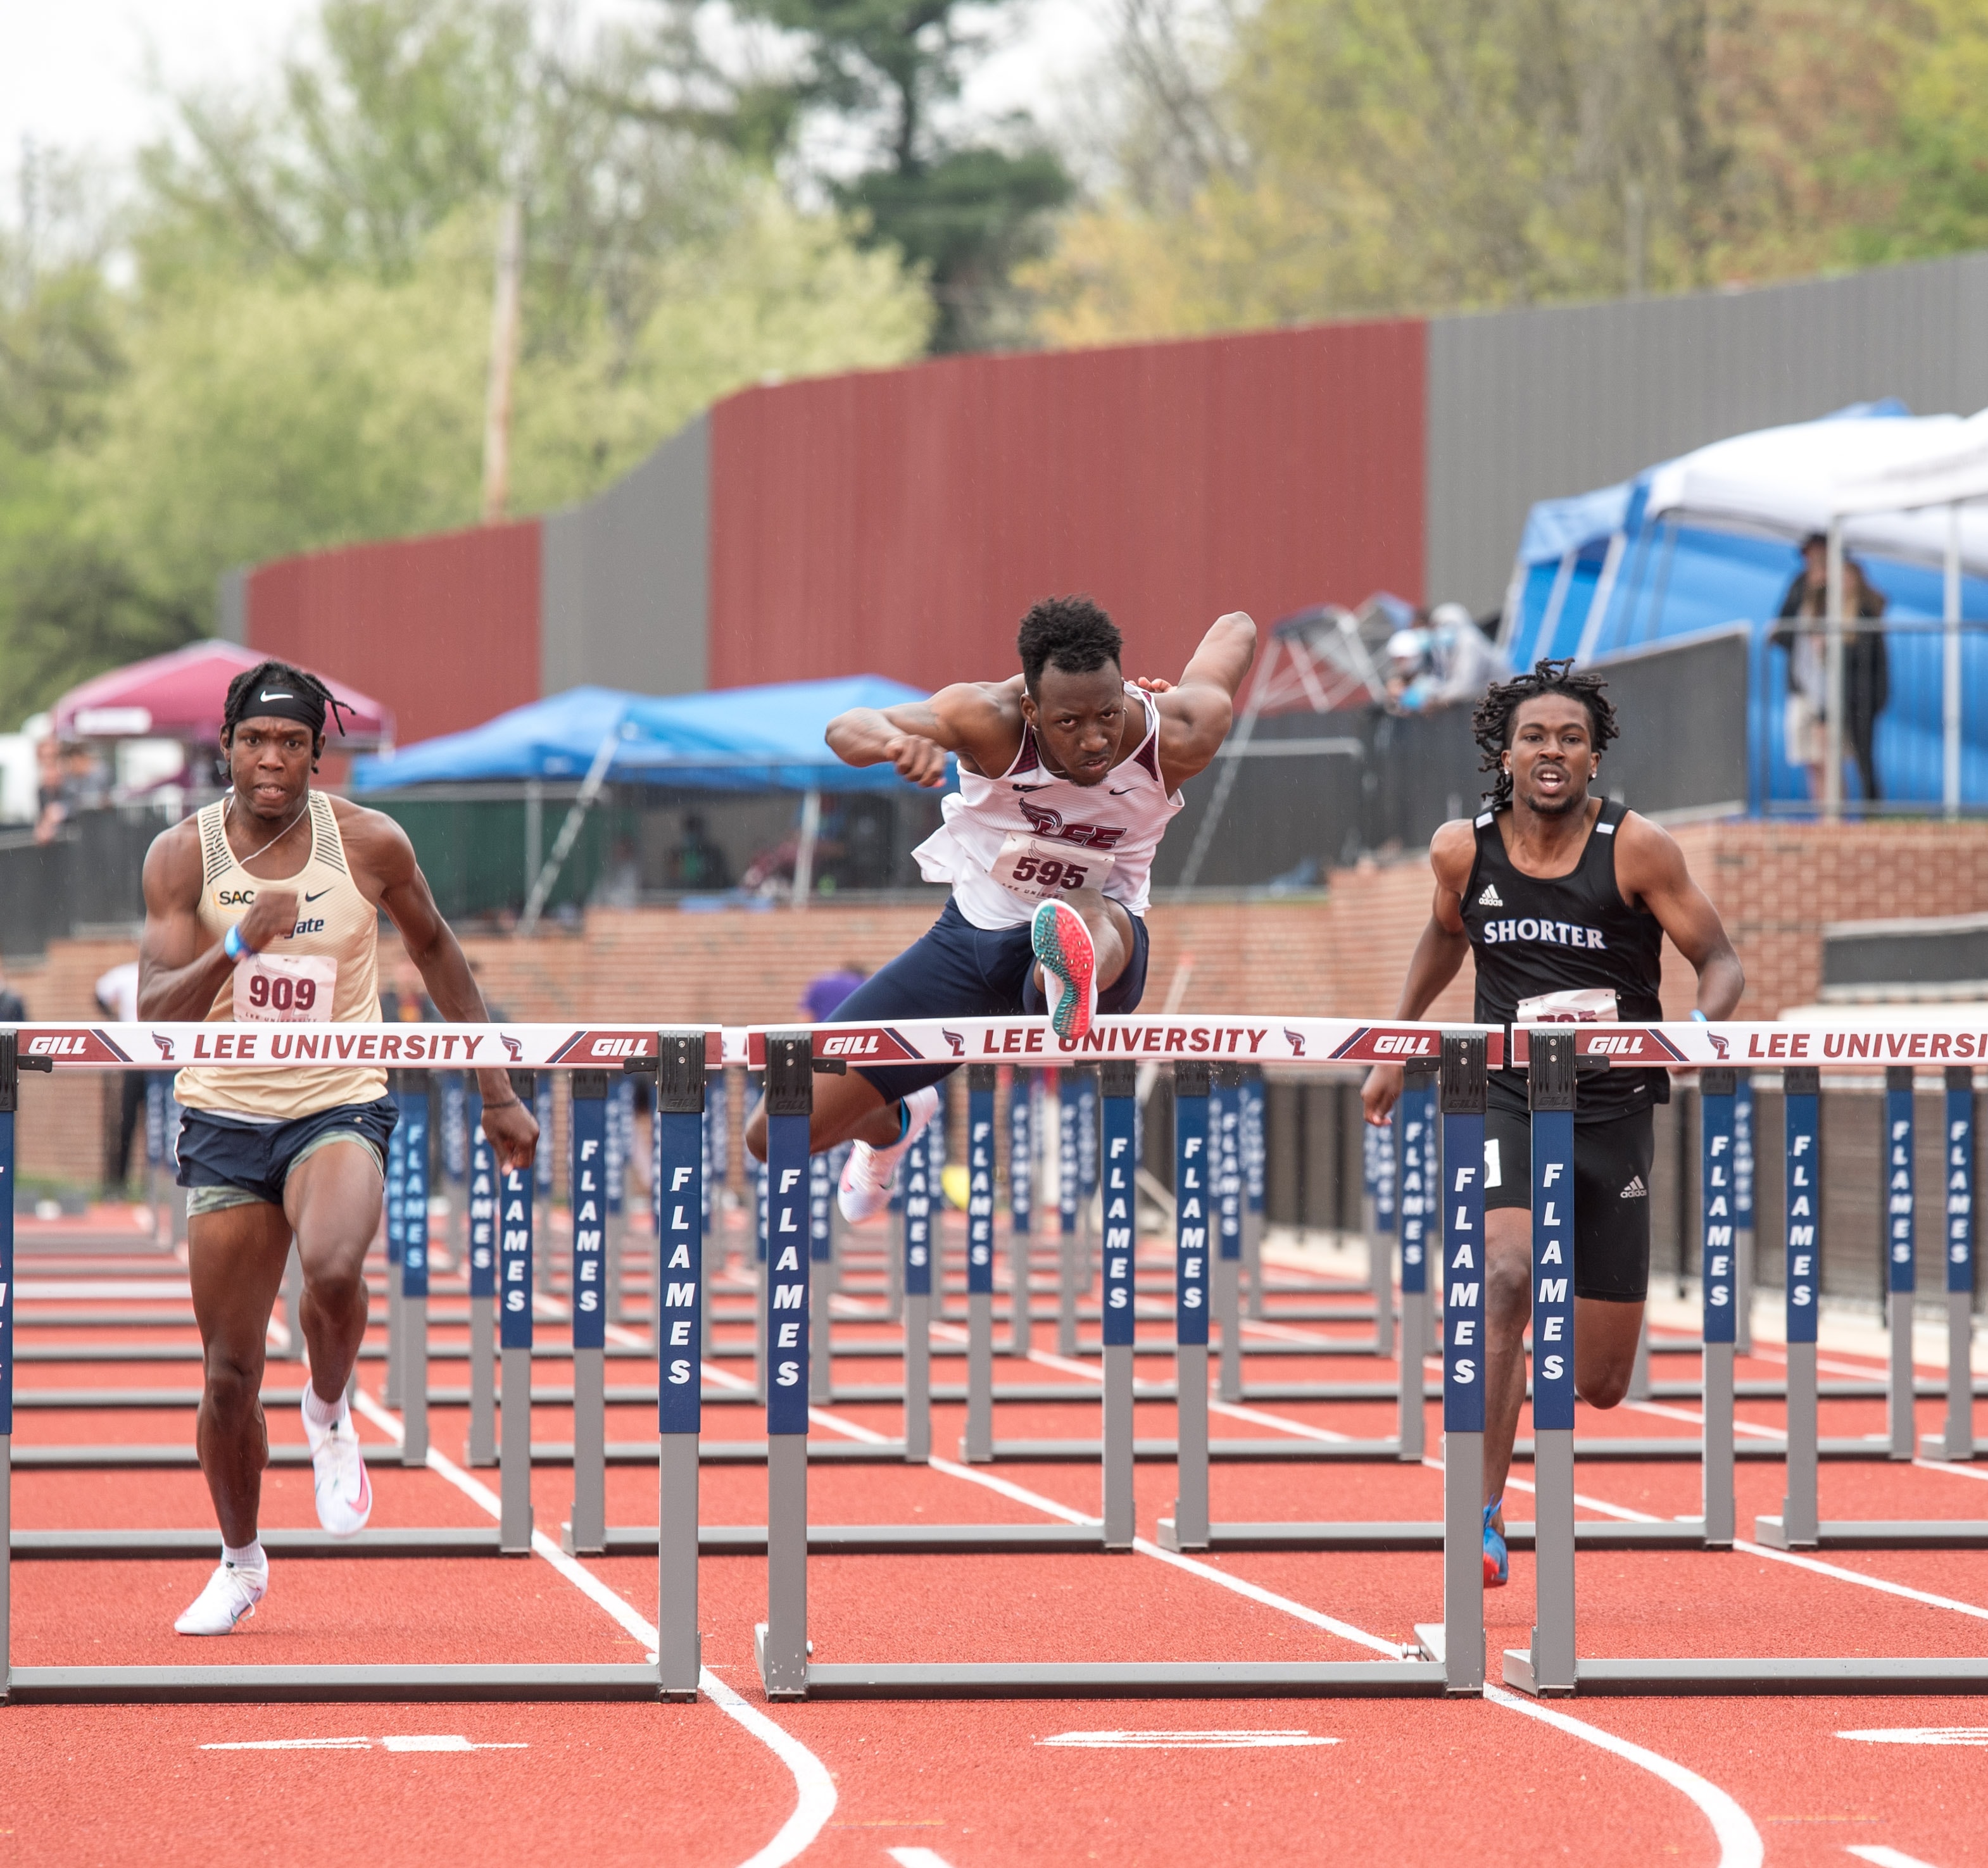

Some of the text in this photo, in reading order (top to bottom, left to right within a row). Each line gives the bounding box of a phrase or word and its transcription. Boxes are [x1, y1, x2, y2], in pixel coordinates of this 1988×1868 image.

[219, 890, 255, 905] SAC
[1012, 856, 1089, 890] 595
[1027, 815, 1128, 851] LEE
[1478, 897, 1503, 907] adidas
[249, 975, 317, 1012] 909
[1483, 918, 1607, 949] SHORTER
[28, 1036, 87, 1054] GILL
[193, 1034, 484, 1060] LEE UNIVERSITY
[591, 1038, 648, 1056] GILL
[822, 1036, 879, 1055] GILL
[983, 1027, 1268, 1054] LEE UNIVERSITY
[1373, 1036, 1430, 1055] GILL
[1587, 1036, 1644, 1054] GILL
[1747, 1033, 1988, 1058] LEE UNIVERSI
[405, 1124, 426, 1268] FLAMES
[503, 1170, 528, 1312] LAMES
[577, 1140, 601, 1312] FLAMES
[969, 1122, 991, 1265] FLAMES
[1106, 1138, 1131, 1308] FLAMES
[1180, 1138, 1205, 1308] FLAMES
[1402, 1122, 1424, 1265] FLAMES
[1707, 1136, 1732, 1306] FLAMES
[1789, 1136, 1814, 1306] FLAMES
[1890, 1120, 1913, 1263] FLAMES
[1947, 1120, 1971, 1263] FLAMES
[665, 1167, 696, 1384] FLAMES
[773, 1169, 804, 1386] FLAMES
[1449, 1167, 1480, 1384] FLAMES
[1538, 1163, 1568, 1380] FLAMES
